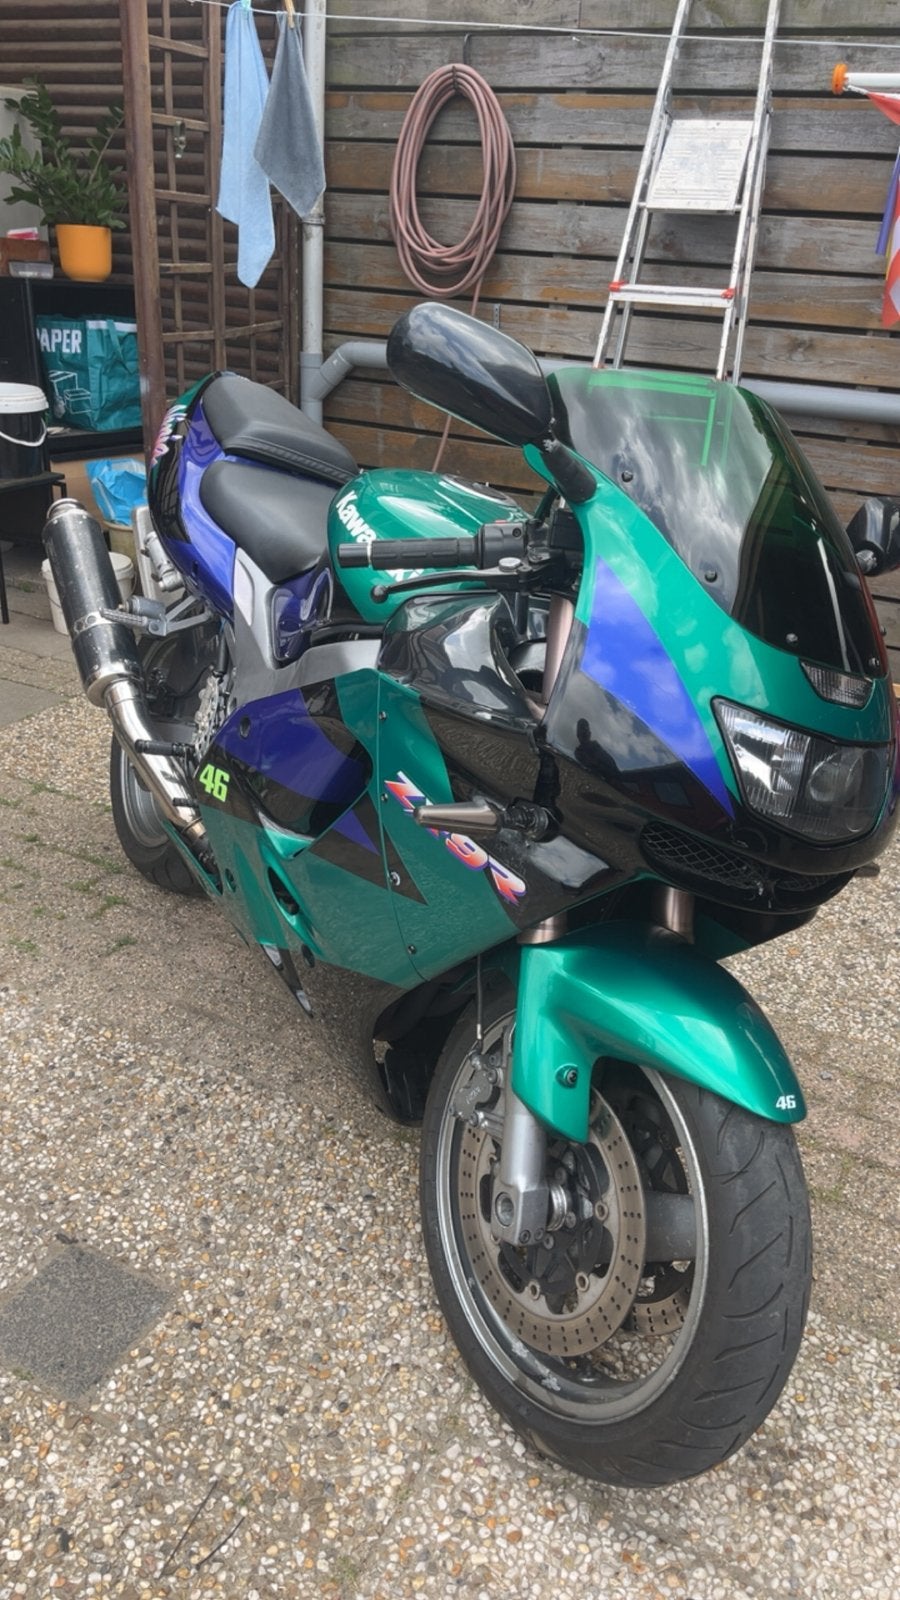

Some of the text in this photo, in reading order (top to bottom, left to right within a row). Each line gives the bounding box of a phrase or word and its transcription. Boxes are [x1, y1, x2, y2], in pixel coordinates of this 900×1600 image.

[36, 327, 82, 353] APER
[199, 763, 230, 802] 46
[775, 1094, 797, 1110] 46
